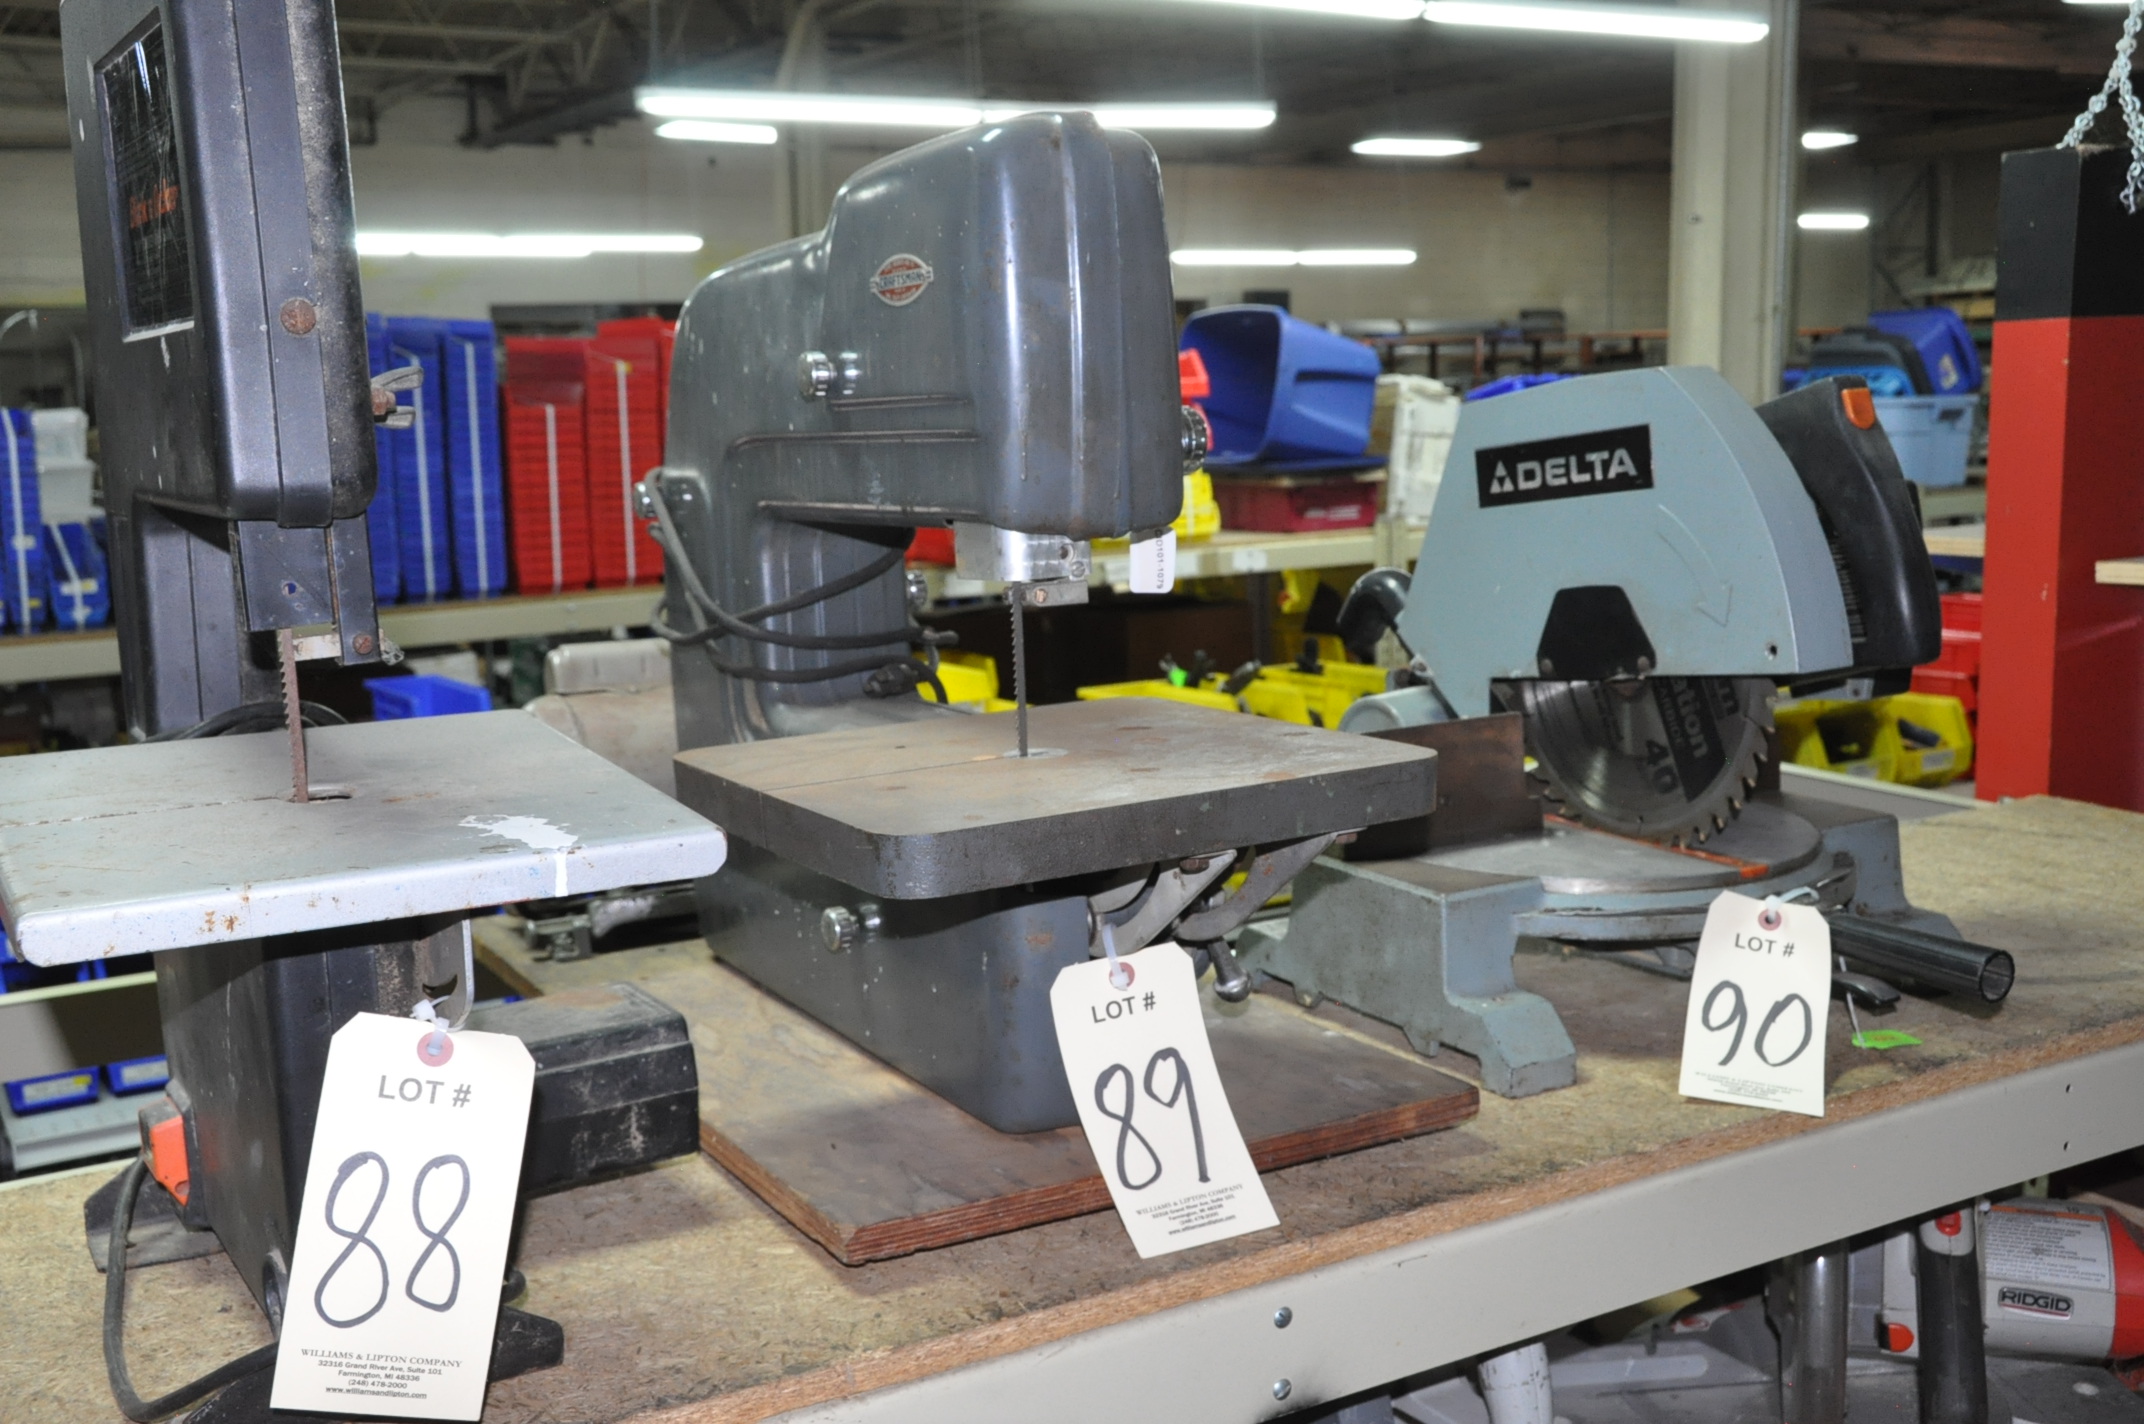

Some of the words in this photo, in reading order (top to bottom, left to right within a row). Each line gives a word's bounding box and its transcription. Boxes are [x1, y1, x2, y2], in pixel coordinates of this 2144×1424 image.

[1516, 447, 1638, 491] DELTA
[1646, 740, 1679, 793] 40
[1735, 933, 1777, 955] LOT
[1783, 942, 1795, 957] #
[1091, 996, 1136, 1023] LOT
[1142, 991, 1157, 1011] #
[1701, 980, 1813, 1067] 90
[378, 1074, 445, 1105] LOT
[452, 1083, 472, 1108] #
[1094, 1046, 1210, 1190] 89
[314, 1150, 471, 1329] 88
[2000, 1290, 2071, 1312] RIDGID
[301, 1348, 354, 1360] WILLIAMS
[356, 1353, 363, 1361] &
[366, 1353, 407, 1364] LIPTON
[409, 1356, 463, 1368] COMPANY
[318, 1359, 343, 1368] 32316
[345, 1361, 368, 1370] Grand
[407, 1366, 425, 1374] Suite
[338, 1369, 382, 1380] Farmington,
[395, 1374, 420, 1382] 48336
[348, 1379, 369, 1387] (248)
[370, 1380, 408, 1389] 478-2000
[325, 1386, 427, 1399] www.williamsandlipton.com
